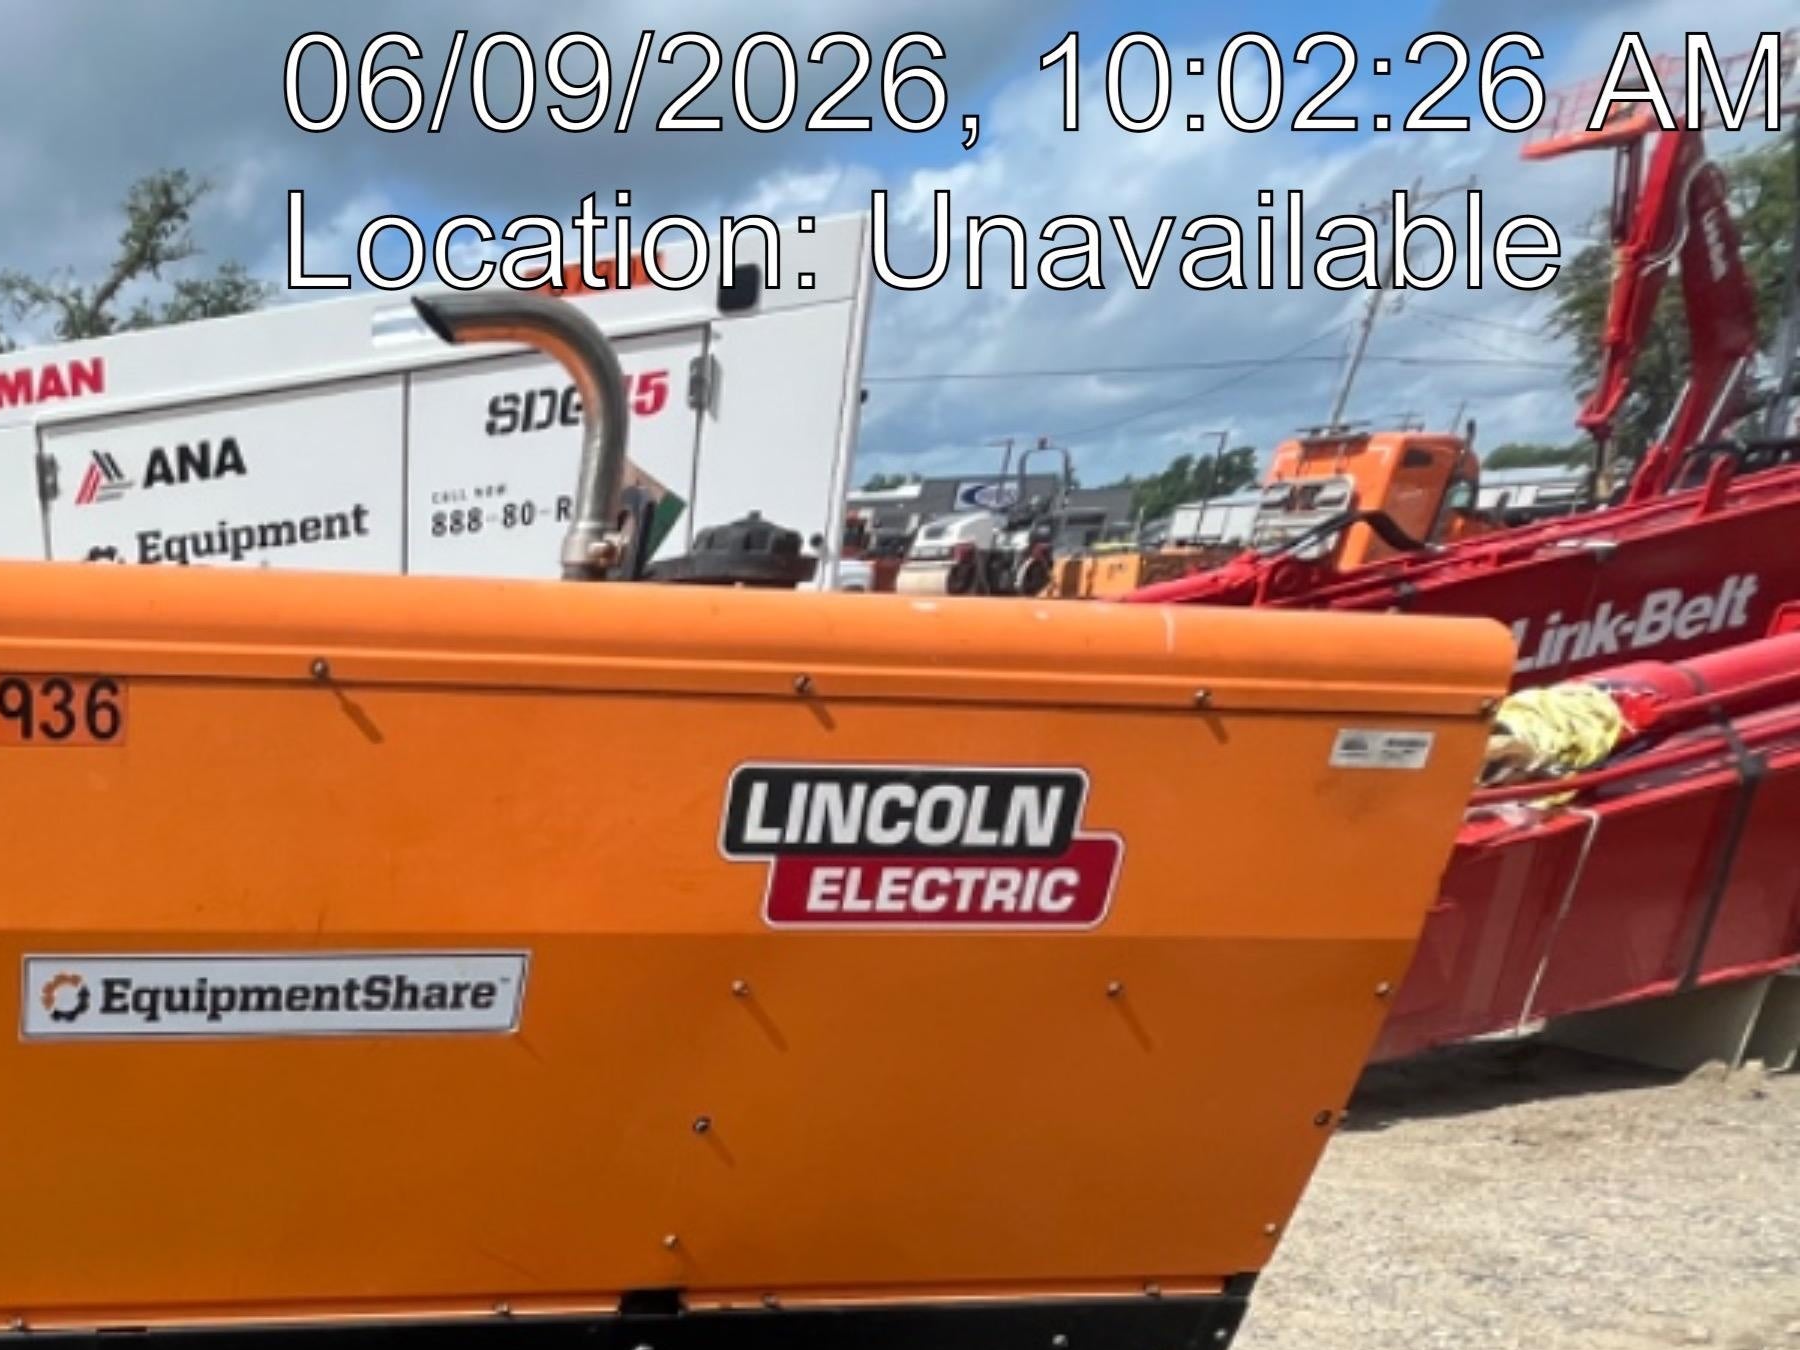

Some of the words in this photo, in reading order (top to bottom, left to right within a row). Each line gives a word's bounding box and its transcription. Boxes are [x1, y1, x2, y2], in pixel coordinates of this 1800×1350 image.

[143, 436, 247, 489] ANA
[136, 503, 369, 566] Equipment
[431, 494, 572, 537] 888-80-R
[1511, 574, 1758, 673] Link-Belt
[742, 782, 1066, 847] LINCOLN
[806, 866, 1080, 913] ELECTRIC
[99, 975, 498, 1022] EquipmentShare
